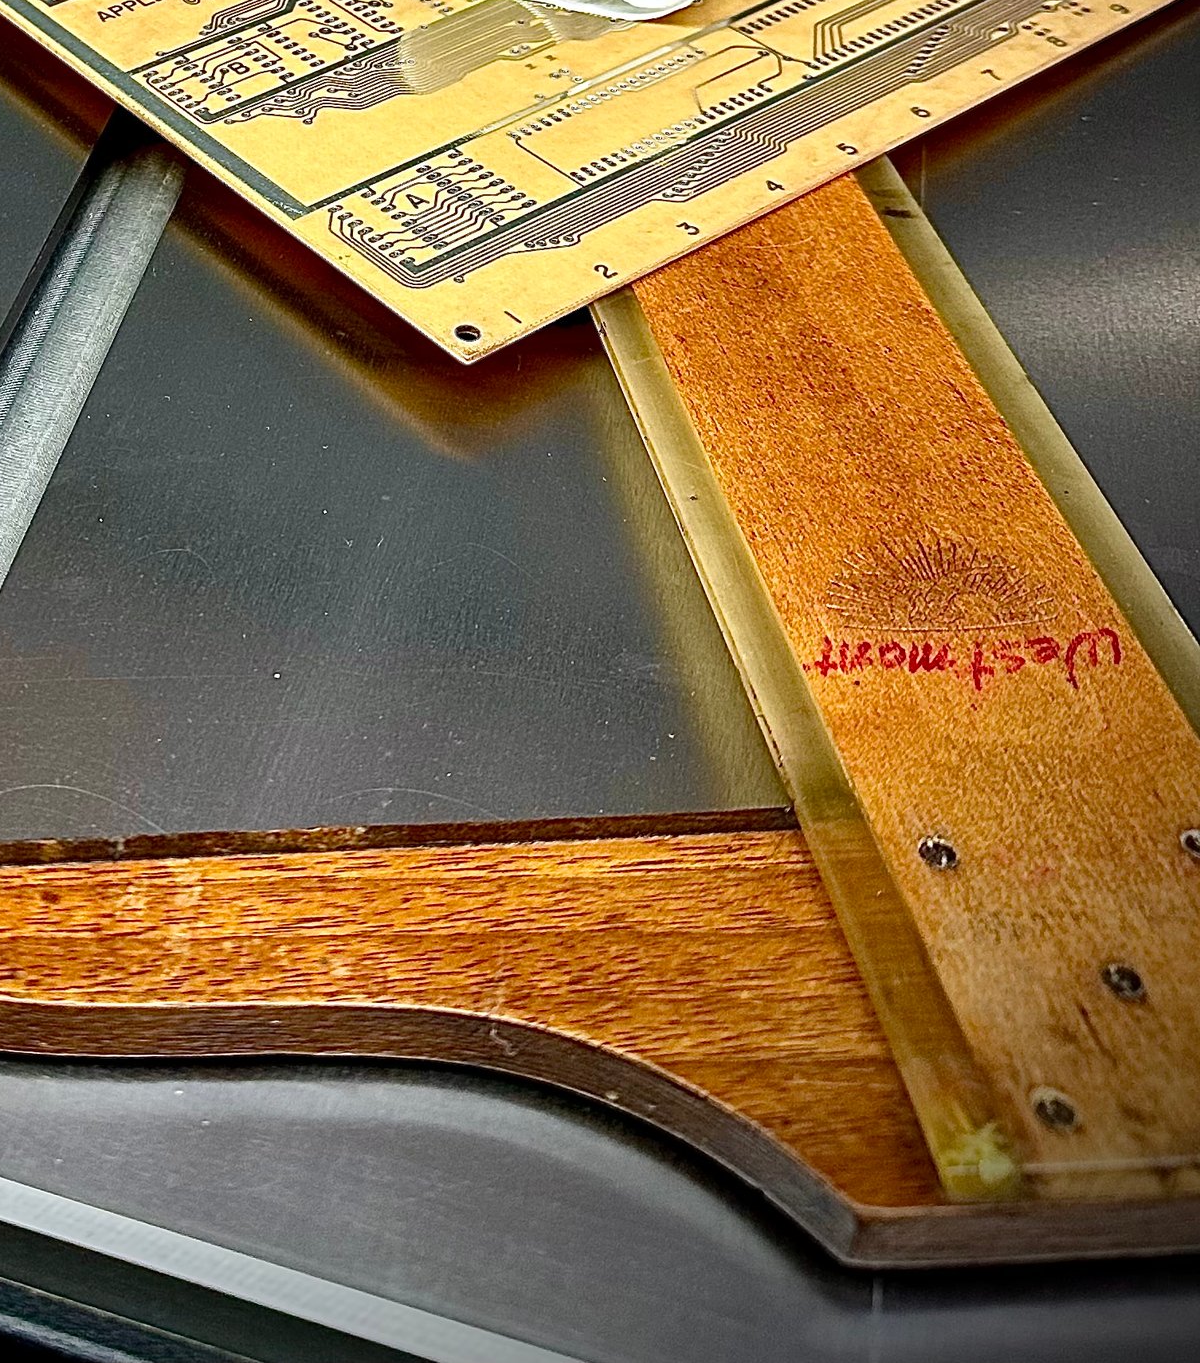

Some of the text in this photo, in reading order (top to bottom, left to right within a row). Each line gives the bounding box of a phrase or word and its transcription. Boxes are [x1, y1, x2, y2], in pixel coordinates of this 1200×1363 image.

[229, 62, 250, 75] B
[593, 263, 618, 280] 2
[676, 222, 700, 236] 3
[765, 179, 785, 194] 4
[836, 143, 859, 156] 5
[910, 106, 931, 119] 6
[980, 68, 1002, 81] 7
[1046, 36, 1068, 49] 8
[1110, 3, 1130, 16] 9
[402, 193, 430, 209] A
